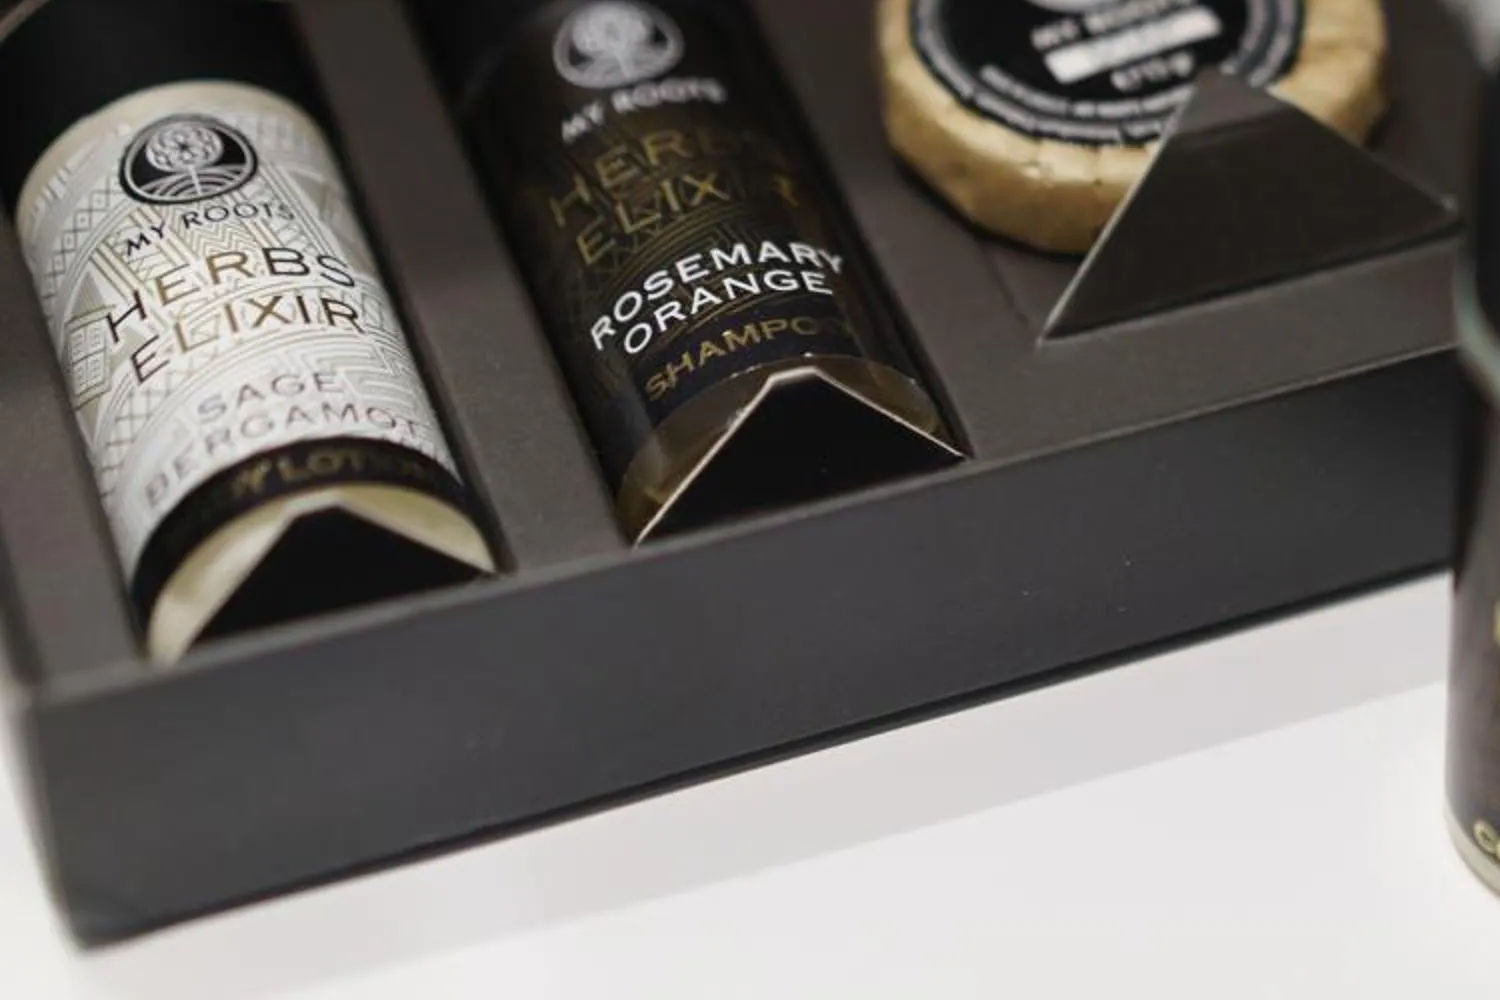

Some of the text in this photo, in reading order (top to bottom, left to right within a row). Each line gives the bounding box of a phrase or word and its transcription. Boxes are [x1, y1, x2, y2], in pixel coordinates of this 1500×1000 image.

[549, 128, 735, 229] HER
[124, 201, 298, 258] MY ROOTS
[107, 246, 357, 344] HERBS
[132, 294, 364, 385] ELIXIR
[590, 239, 844, 351] ROSEMARY
[623, 268, 834, 355] ORANGE
[198, 371, 345, 425] SAGE
[645, 314, 853, 403] SHAMPO
[145, 402, 420, 509] BERGAMOT
